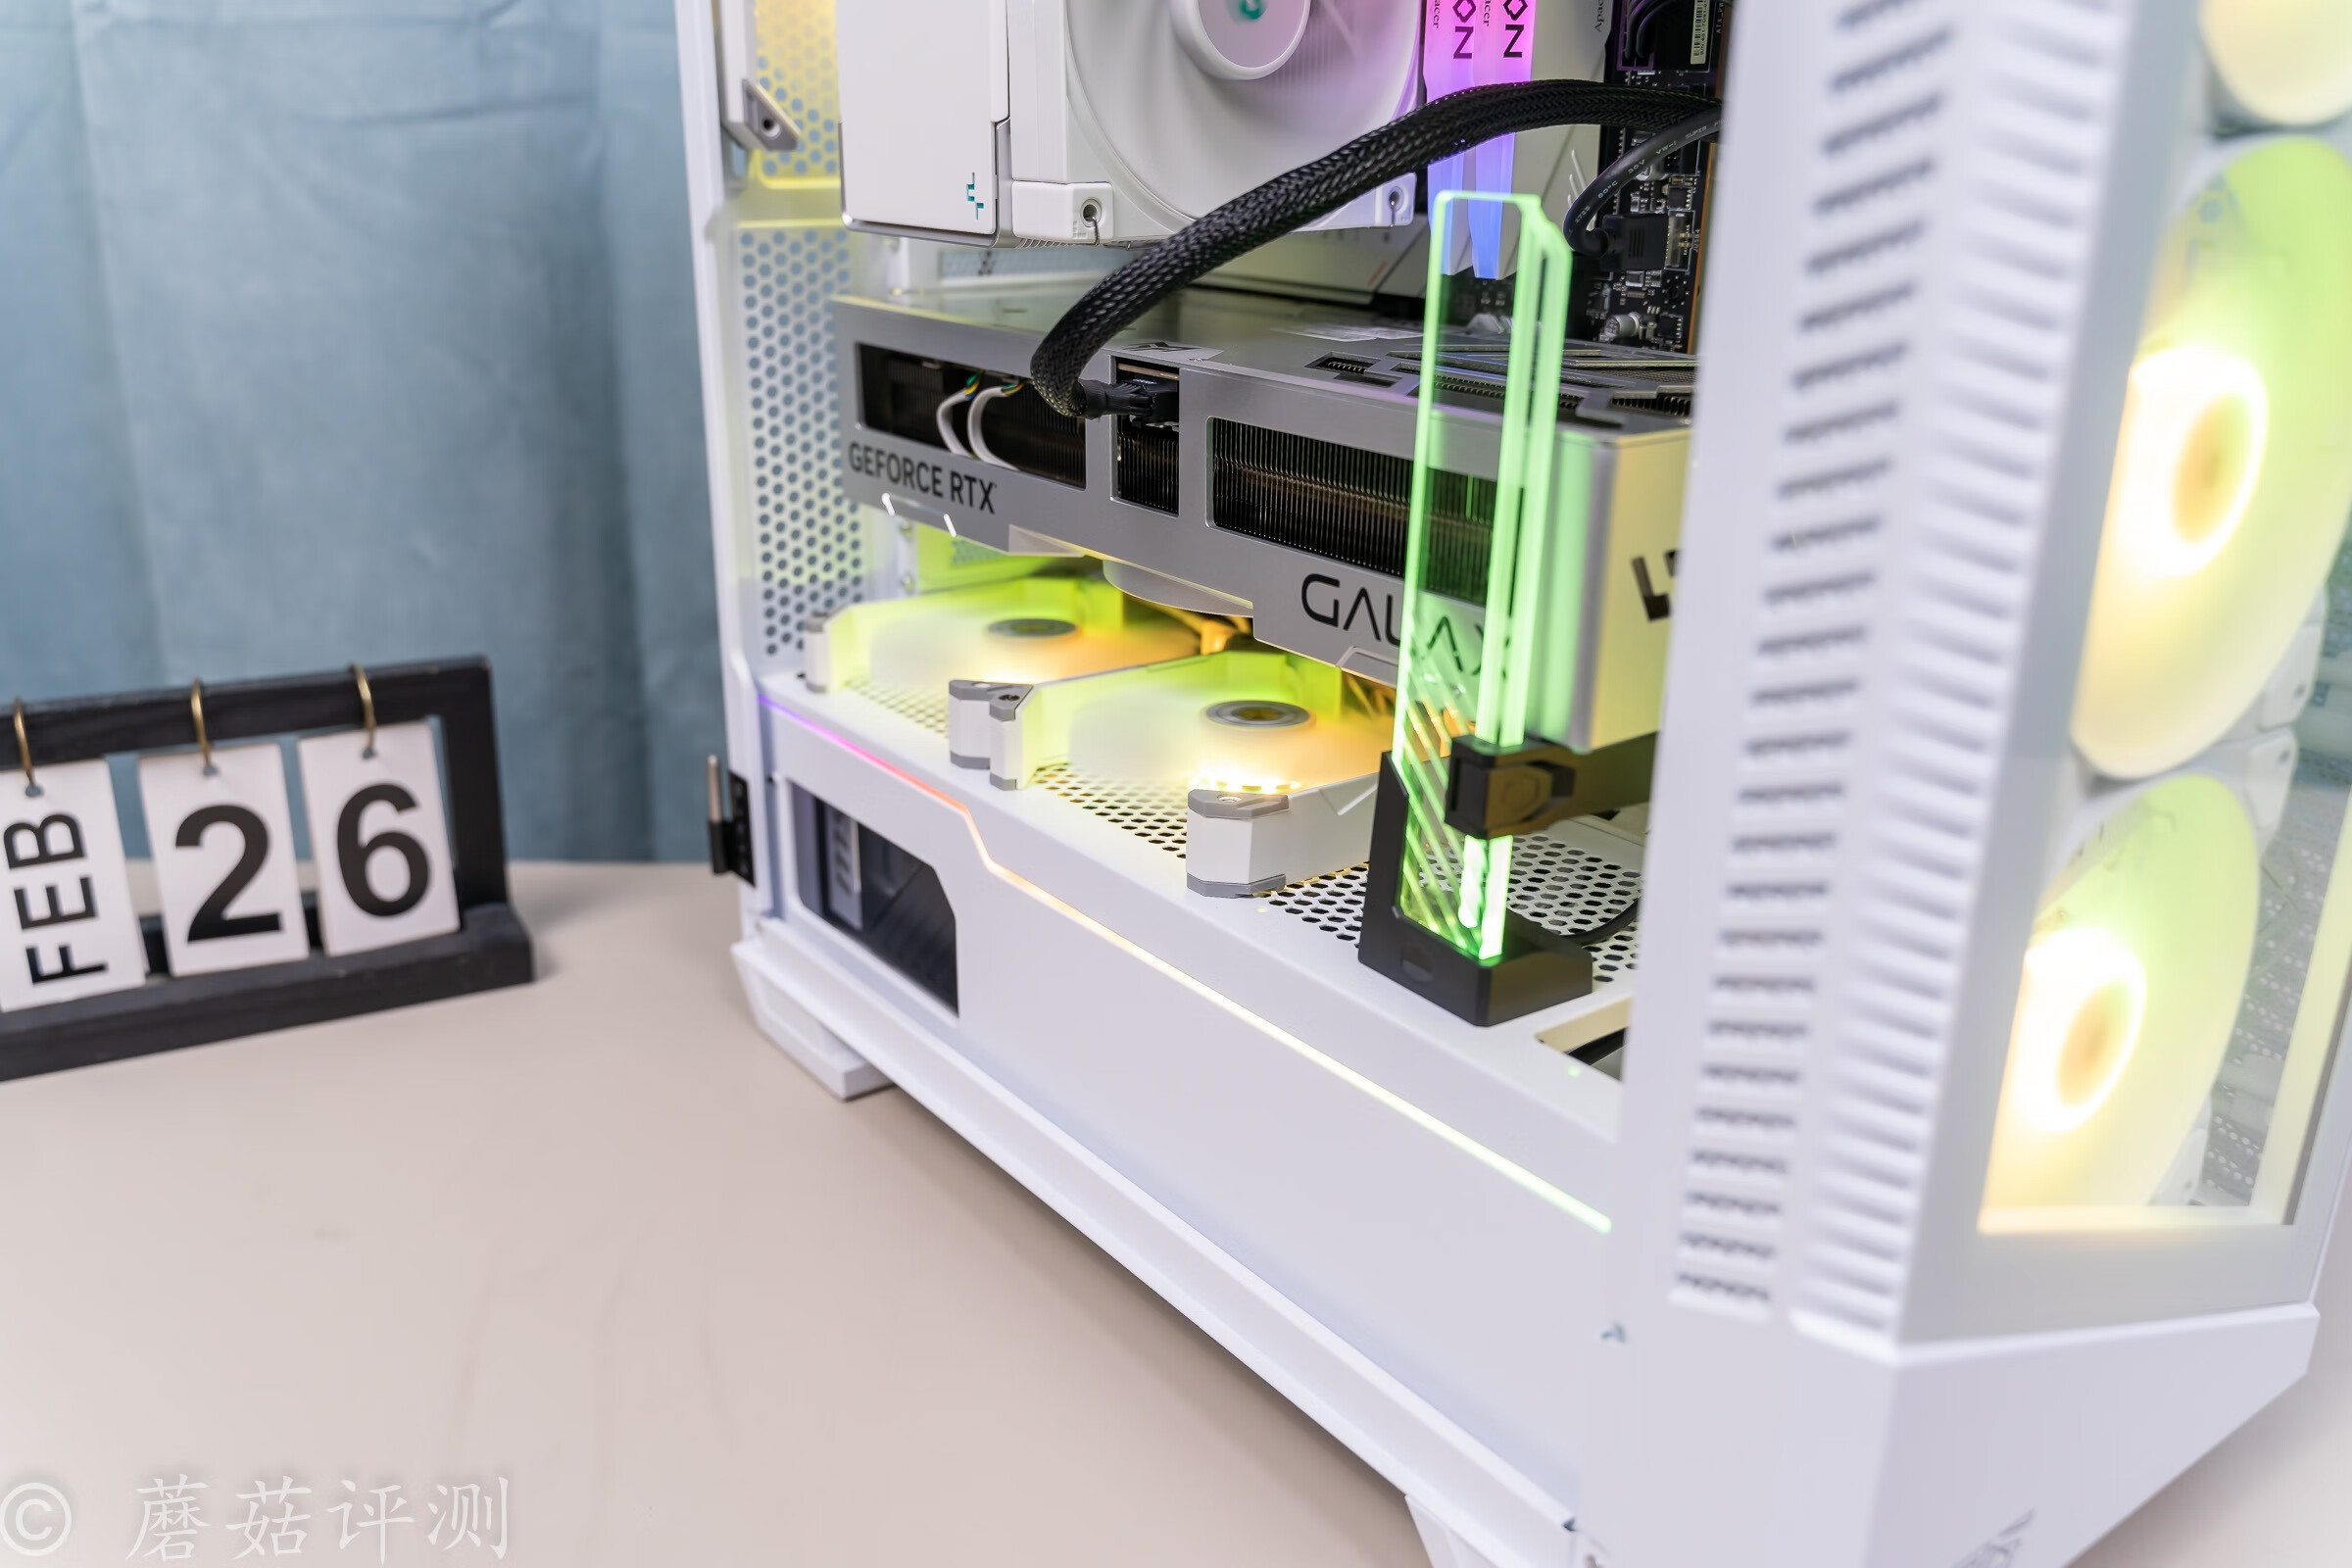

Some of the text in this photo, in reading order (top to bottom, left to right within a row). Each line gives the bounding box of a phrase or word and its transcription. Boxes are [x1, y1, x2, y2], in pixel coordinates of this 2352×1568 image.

[849, 441, 996, 515] GEFORCE RTX
[3, 812, 109, 986] FEB
